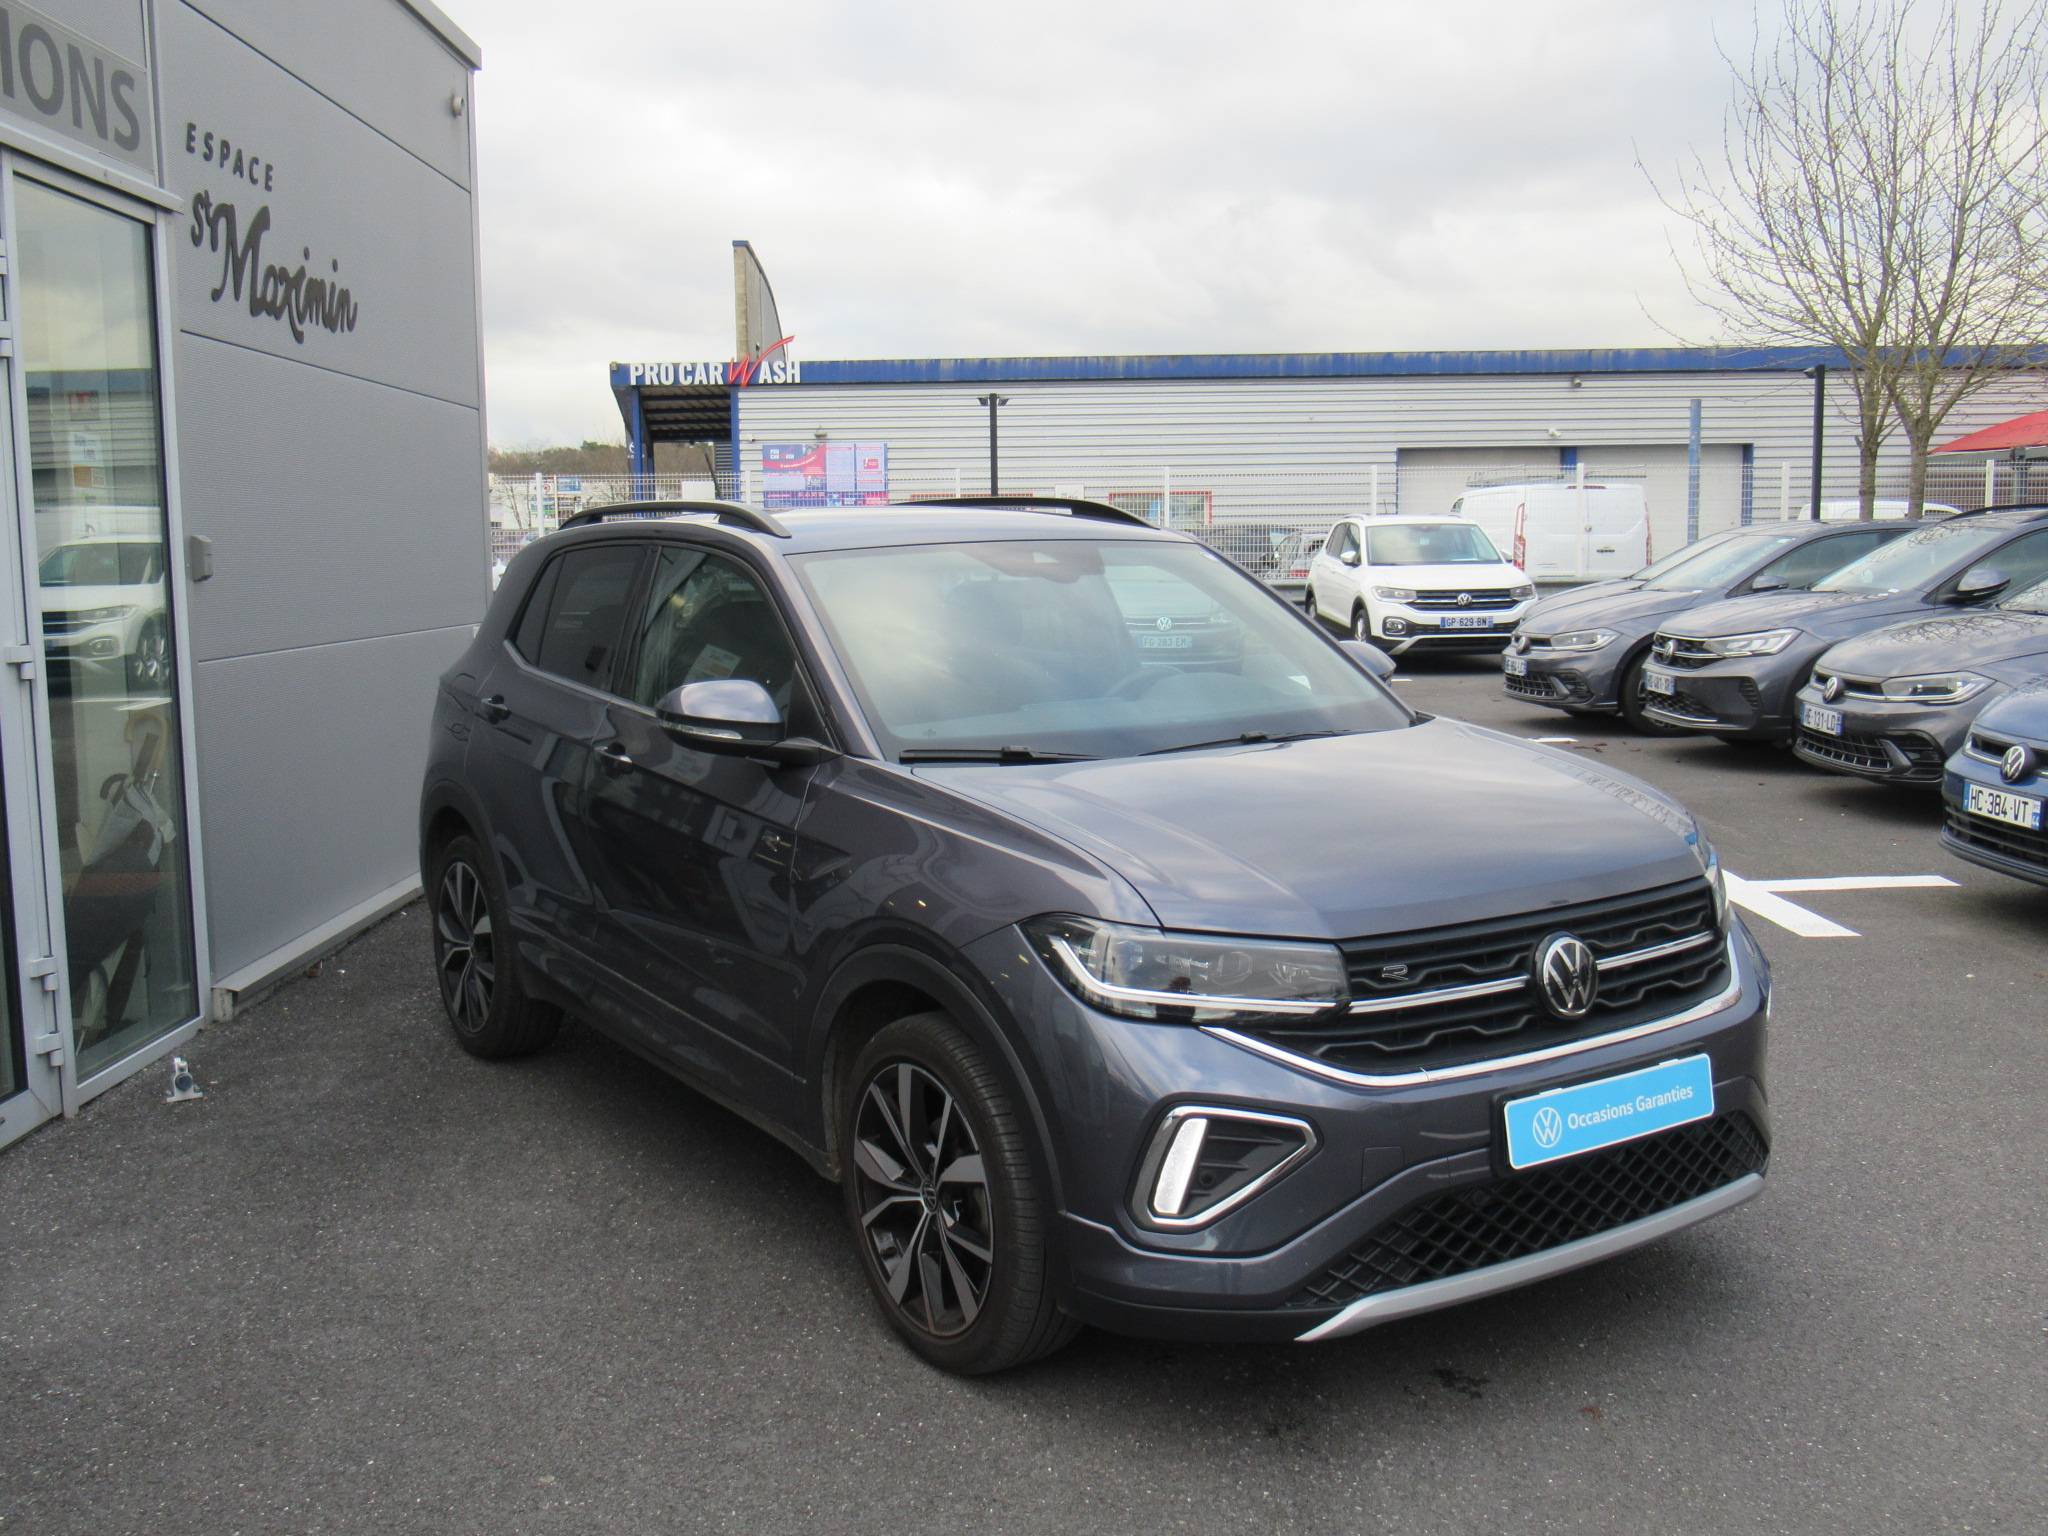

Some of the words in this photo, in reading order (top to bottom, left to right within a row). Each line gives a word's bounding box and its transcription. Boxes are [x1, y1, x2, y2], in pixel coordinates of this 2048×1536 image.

[186, 122, 274, 192] ESPACE
[191, 189, 214, 248] St
[210, 203, 358, 344] Maximin
[629, 362, 675, 385] PRO
[678, 362, 724, 385] CAR
[728, 335, 800, 388] WASH
[1969, 787, 2029, 823] HC-384-VT
[1567, 1103, 1633, 1129] Occasions
[1635, 1084, 1693, 1112] Garanties
